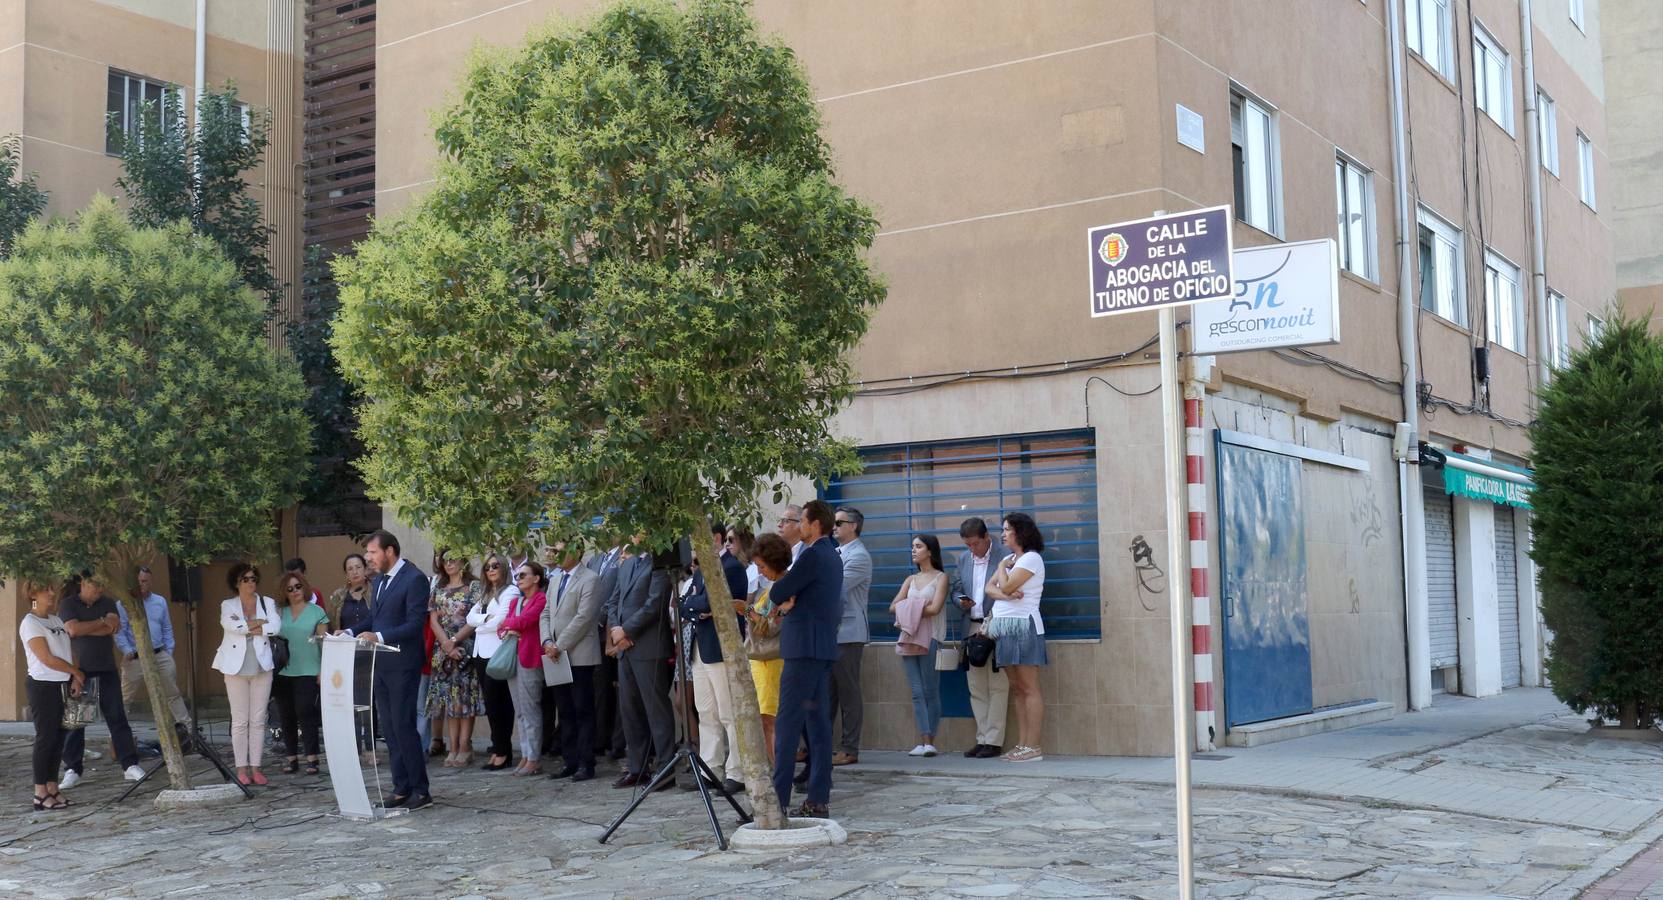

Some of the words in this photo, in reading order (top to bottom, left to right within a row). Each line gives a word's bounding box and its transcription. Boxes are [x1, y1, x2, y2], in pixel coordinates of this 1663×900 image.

[1147, 219, 1207, 242] CALLE
[1148, 246, 1165, 258] DE
[1169, 243, 1186, 255] LA
[1106, 260, 1188, 288] ABOGACIA
[1192, 260, 1215, 275] DEL
[1096, 286, 1149, 309] TURNO
[1153, 286, 1170, 302] DE
[1174, 275, 1227, 299] OFICIO
[1220, 336, 1267, 347] OUTSOURCING
[1268, 333, 1304, 343] COMERCIAL
[1465, 474, 1505, 497] PANIFICADORA
